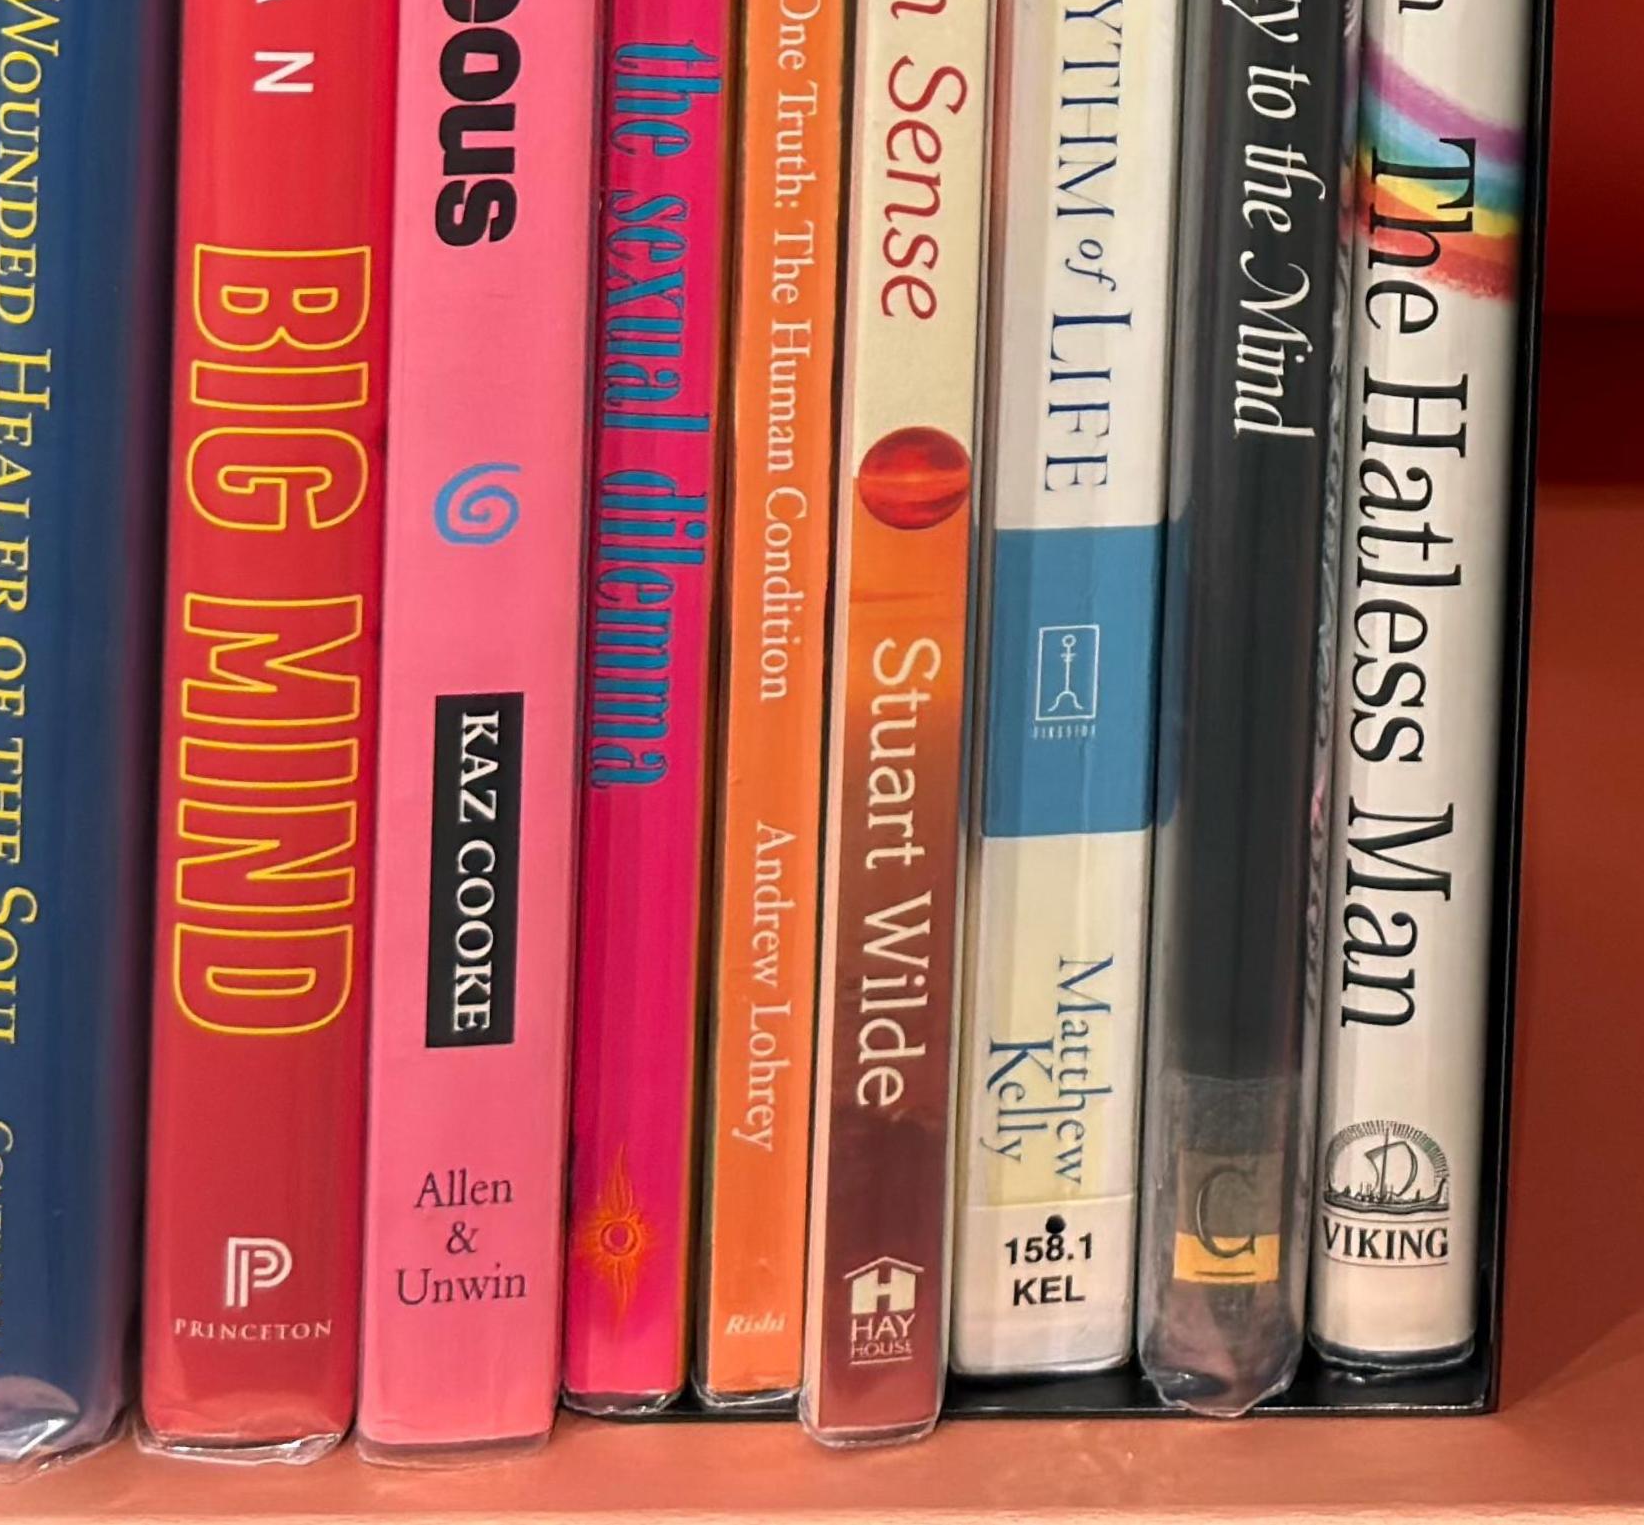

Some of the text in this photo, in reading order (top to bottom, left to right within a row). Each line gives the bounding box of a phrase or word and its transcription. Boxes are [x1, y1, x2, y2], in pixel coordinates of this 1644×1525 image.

[774, 81, 820, 210] Truth:
[1247, 63, 1312, 121] to
[881, 54, 969, 321] Sense
[1242, 145, 1327, 233] the
[773, 221, 817, 307] The
[1065, 237, 1117, 291] of
[768, 319, 812, 475] Human
[1044, 313, 1132, 494] LIFE
[1234, 251, 1317, 441] Mind
[589, 39, 722, 790] the sexual dilemma
[173, 243, 371, 1037] BIG MIND
[760, 485, 808, 702] Condition
[1341, 137, 1476, 1029] The Hatless Man
[453, 709, 501, 1034] KAZ COOKE
[856, 636, 942, 1107] Stuart Wilde
[733, 820, 797, 1152] Andrew Lohrey
[981, 1038, 1055, 1163] Kelly
[1056, 954, 1114, 1186] Matthew
[415, 1170, 514, 1209] Allen
[446, 1221, 476, 1255] &
[1004, 1233, 1094, 1266] 158.1
[1322, 1218, 1449, 1259] VIKING
[175, 1317, 334, 1343] PRINCETON
[396, 1263, 527, 1306] Unwin
[851, 1313, 915, 1342] HAY
[1012, 1276, 1086, 1306] KEL
[850, 1340, 912, 1359] HOUSE
